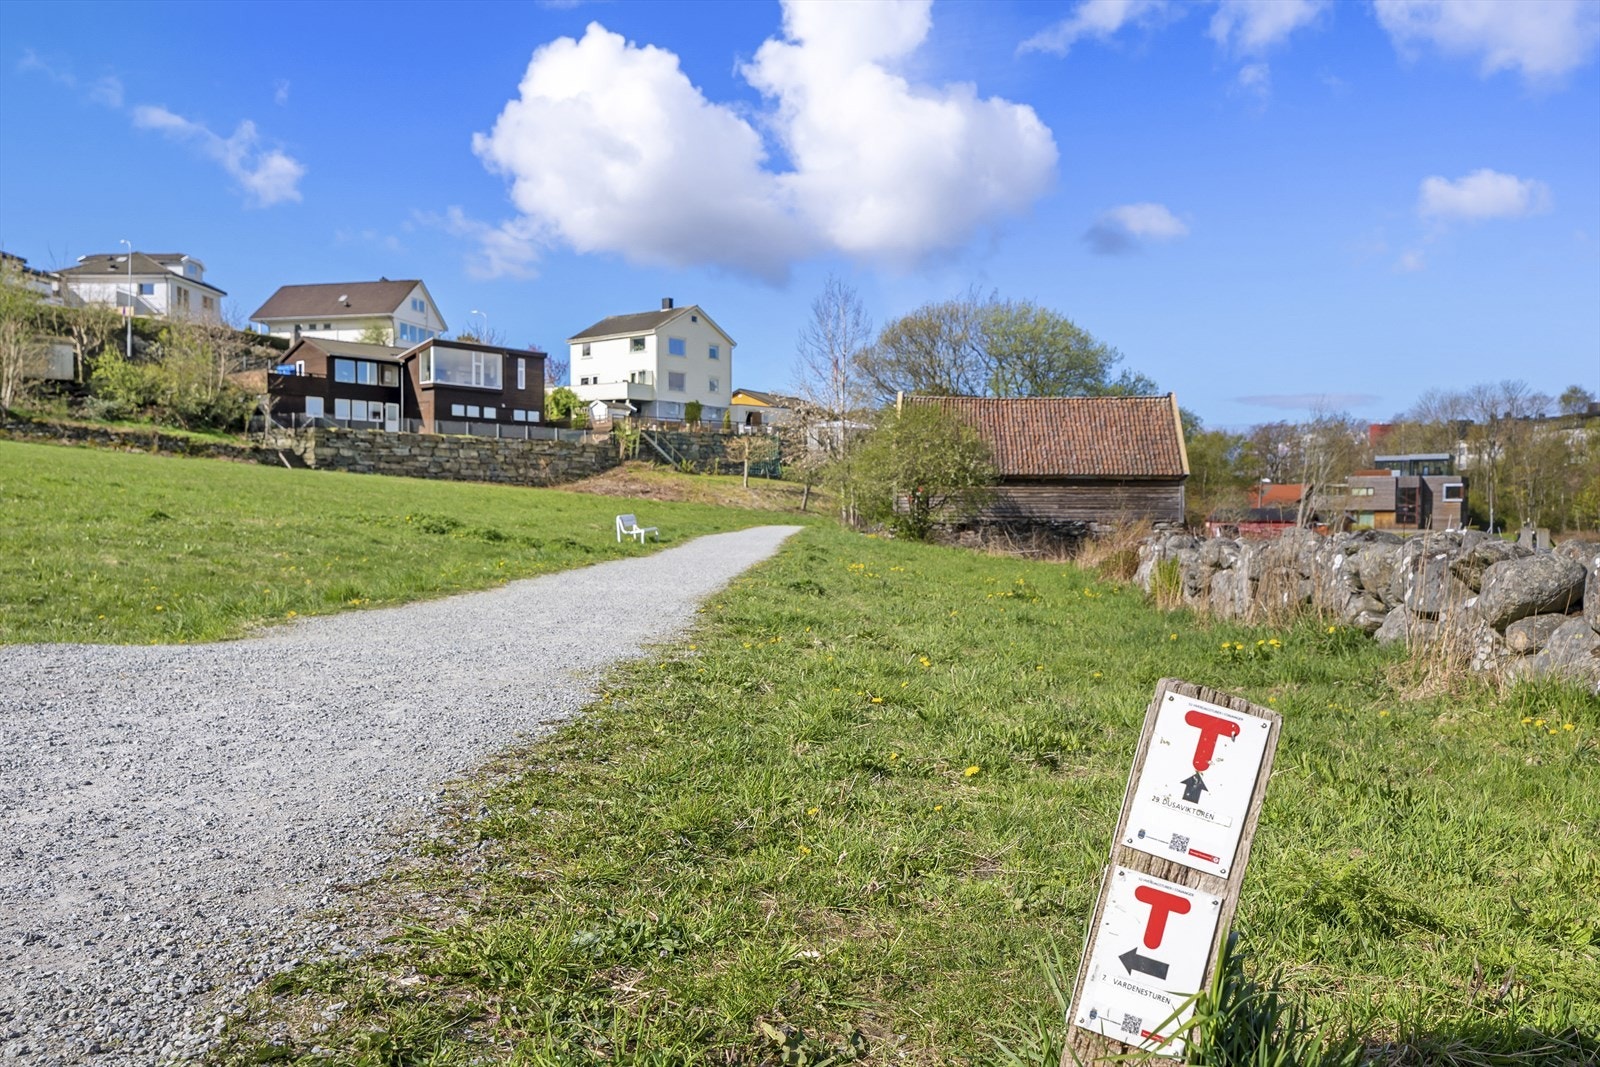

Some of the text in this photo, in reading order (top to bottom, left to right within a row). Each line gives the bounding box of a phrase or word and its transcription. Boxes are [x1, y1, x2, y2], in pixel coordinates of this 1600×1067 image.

[1184, 710, 1241, 772] T
[1134, 885, 1192, 950] T
[1113, 978, 1171, 1005] VARDENESTUREN
